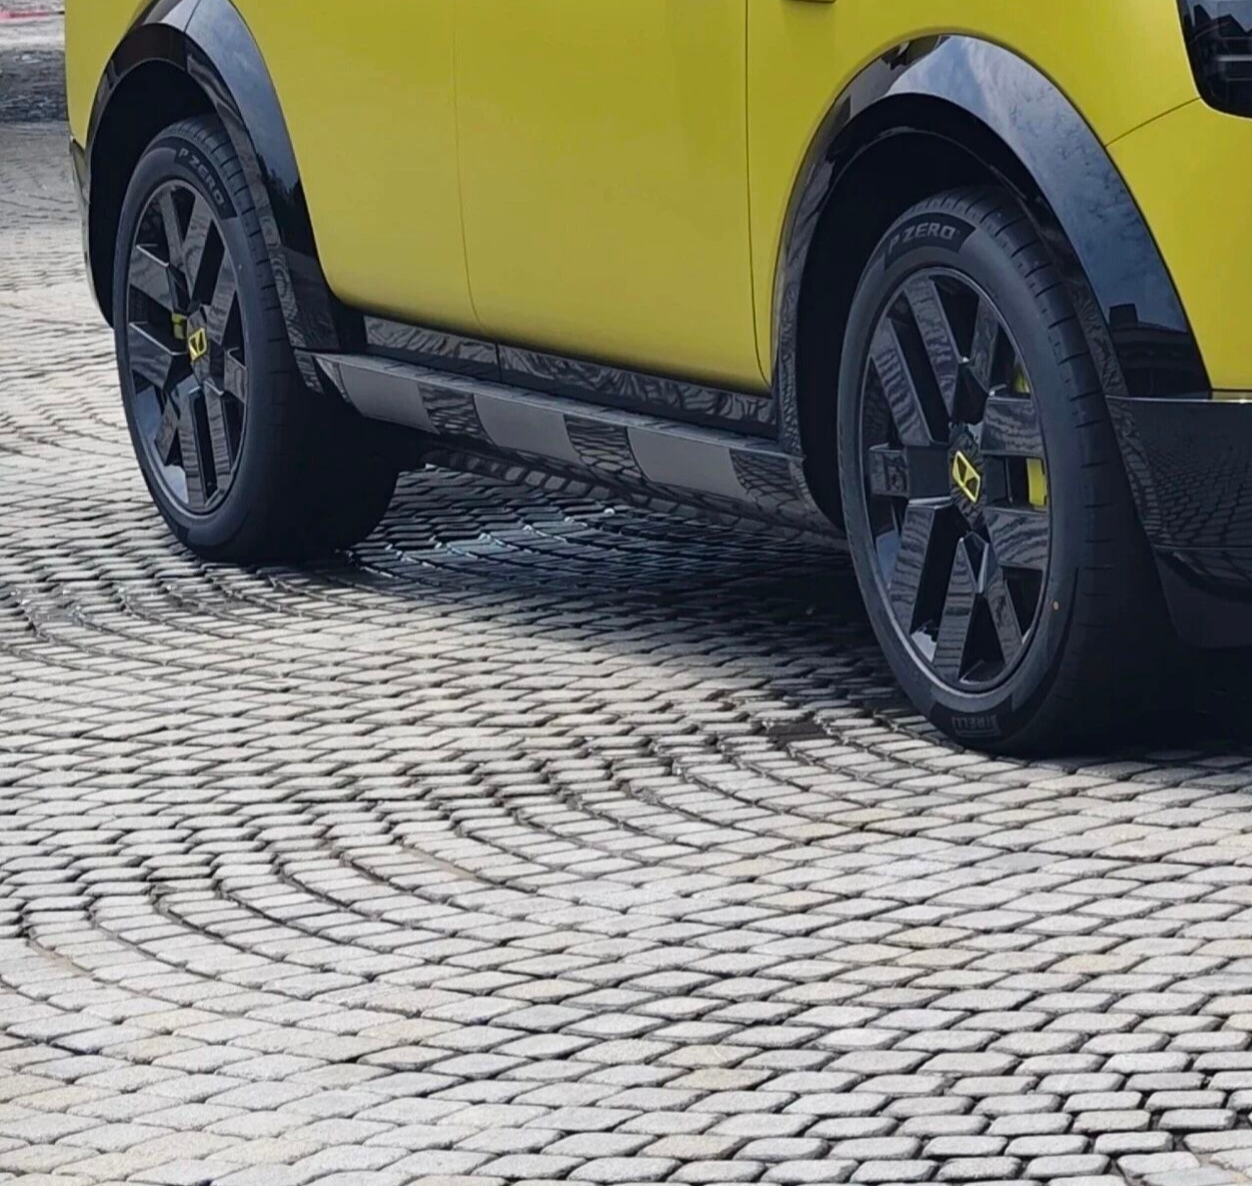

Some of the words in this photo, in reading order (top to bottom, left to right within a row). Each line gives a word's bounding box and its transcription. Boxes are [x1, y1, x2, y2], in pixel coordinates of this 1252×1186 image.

[188, 155, 225, 204] ZERO
[888, 234, 900, 255] P
[902, 222, 956, 243] ZERO
